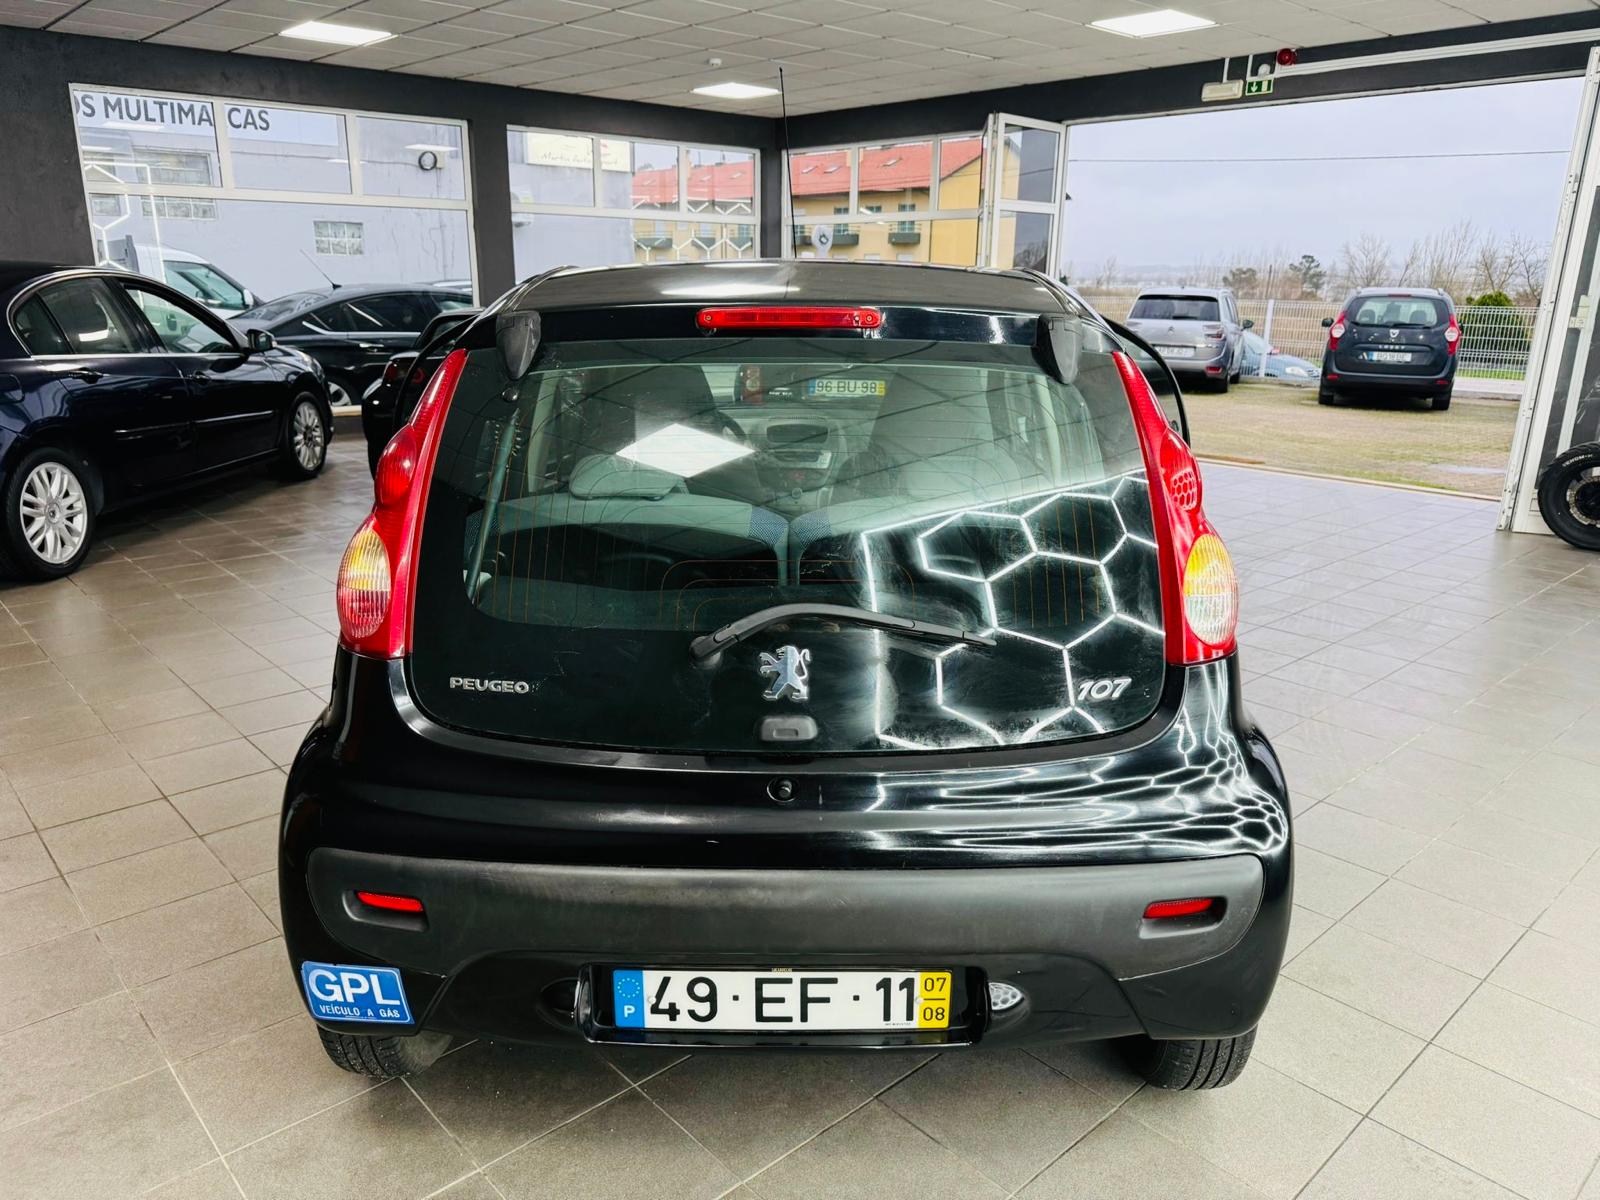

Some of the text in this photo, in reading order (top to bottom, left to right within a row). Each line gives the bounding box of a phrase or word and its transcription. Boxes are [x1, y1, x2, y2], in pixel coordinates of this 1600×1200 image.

[449, 677, 529, 694] PEUGEO
[1077, 676, 1132, 701] 107
[308, 968, 400, 1005] GPL
[924, 977, 947, 992] 07
[319, 1003, 360, 1017] VEÍCULO
[367, 1008, 375, 1017] A
[379, 1007, 400, 1018] GÁS
[623, 1005, 636, 1018] P
[923, 1006, 945, 1022] 08
